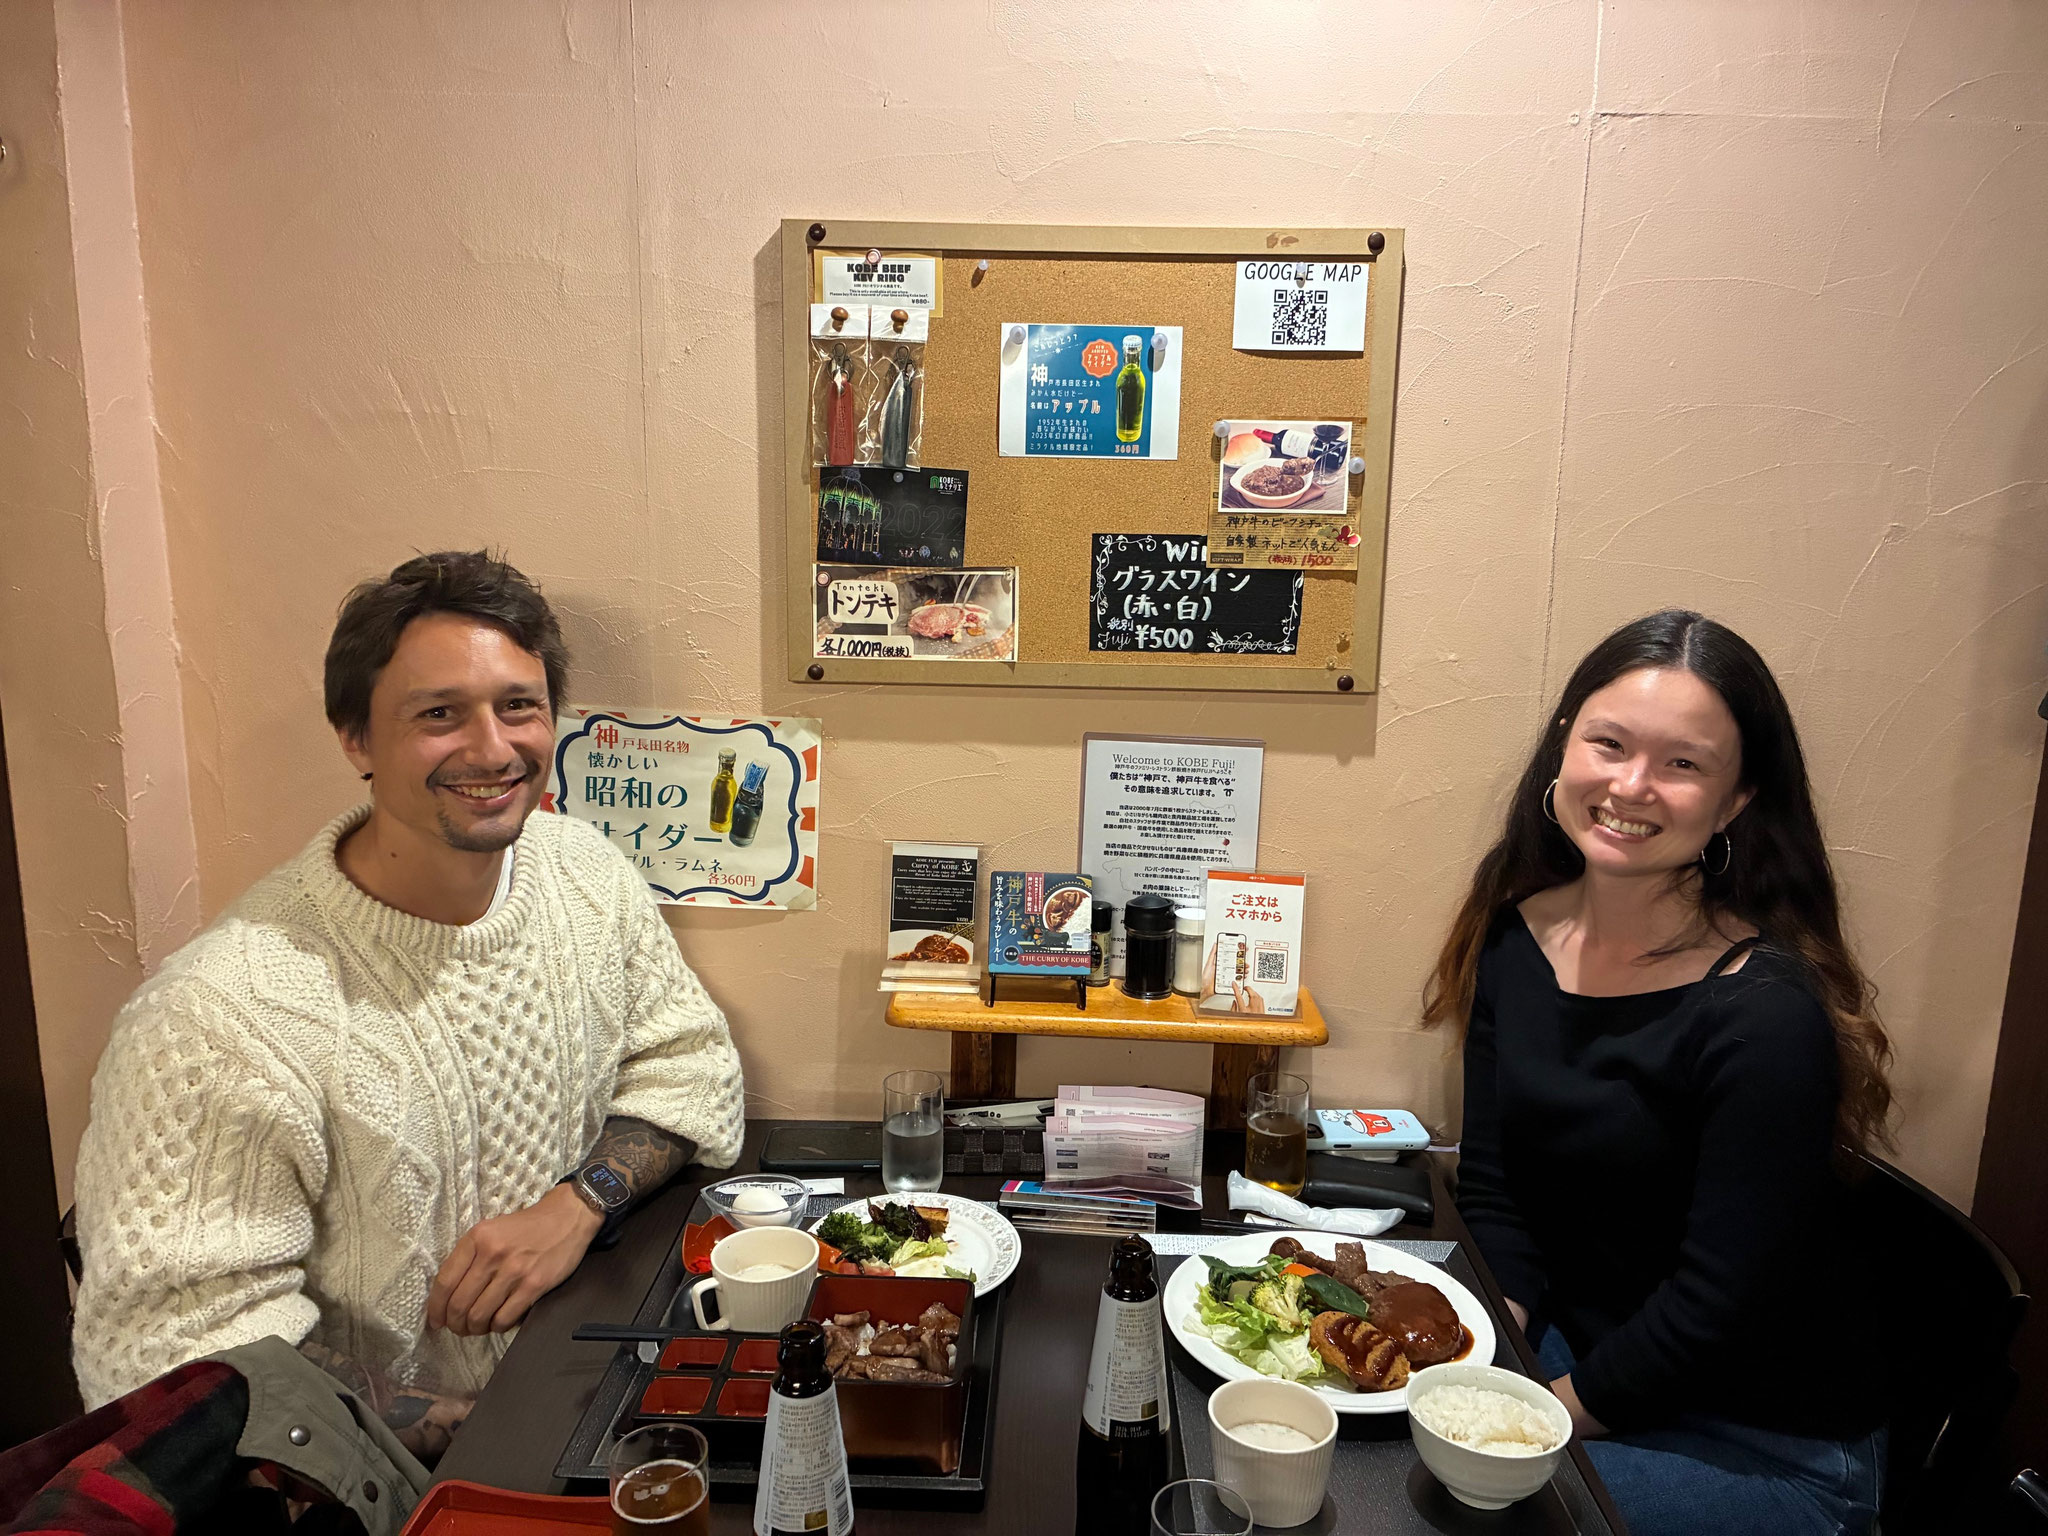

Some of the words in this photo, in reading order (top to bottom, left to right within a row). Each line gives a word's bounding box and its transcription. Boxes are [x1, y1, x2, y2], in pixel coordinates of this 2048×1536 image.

[847, 263, 878, 273] KOBE
[882, 264, 911, 274] BEEF
[1244, 263, 1314, 281] GOOGLE
[1323, 264, 1362, 282] MAP
[853, 274, 874, 282] KEY
[877, 274, 905, 283] RING
[1087, 353, 1112, 361] アップル
[1114, 444, 1140, 454] 360円
[939, 476, 955, 485] KOBE
[880, 501, 964, 542] 2022
[1300, 554, 1334, 567] 1500
[1112, 565, 1250, 592] グラスワイン
[834, 581, 885, 593] Tonteki
[832, 590, 897, 620] トンテキ
[1107, 616, 1134, 632] 税別
[1098, 631, 1132, 650] Fuji
[1134, 624, 1194, 650] ¥500
[594, 723, 690, 754] 神戸長田名物
[587, 751, 659, 770] 懐かしい
[1112, 753, 1160, 766] Welcome
[1163, 757, 1174, 766] to
[1176, 757, 1209, 768] KOBE
[1211, 758, 1236, 770] Fuji!
[585, 775, 688, 809] 昭和の
[911, 862, 929, 870] Curry
[708, 872, 756, 887] 各360円
[1005, 875, 1023, 935] 神戸牛の
[1231, 893, 1279, 908] ご注文は
[1225, 908, 1283, 923] スマホから
